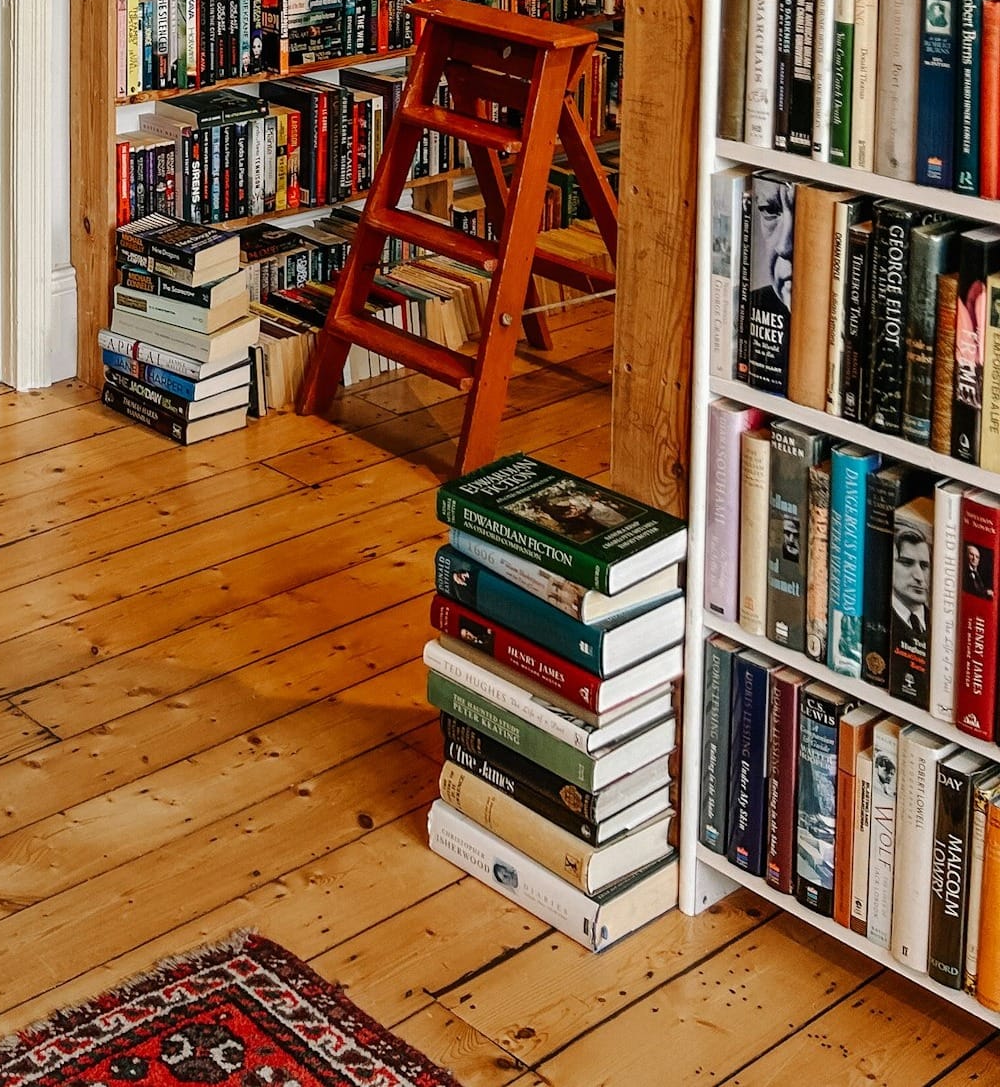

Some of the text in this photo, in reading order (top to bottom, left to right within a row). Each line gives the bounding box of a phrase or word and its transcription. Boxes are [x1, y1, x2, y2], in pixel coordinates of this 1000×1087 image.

[158, 10, 168, 54] SILENCED
[783, 8, 793, 54] DARKNESS
[962, 30, 977, 65] Burns
[832, 31, 846, 125] You Can't Catch Death
[858, 47, 868, 100] Donald Thomas
[126, 278, 155, 292] CONNELLY
[128, 272, 152, 284] MICHAEL
[849, 254, 865, 337] TELLER OF TALES
[877, 275, 887, 301] LIFE
[885, 224, 905, 348] GEORGE ELIOT
[750, 323, 784, 345] DICKEY
[751, 308, 784, 330] JAMES
[148, 370, 183, 391] HARPER
[771, 432, 795, 447] JOAN
[771, 441, 805, 458] MELLEN
[459, 458, 538, 495] EDWARDIAN
[480, 470, 537, 497] FICTION
[463, 508, 573, 567] EDWARDIAN FICTION
[467, 540, 496, 565] 1606
[471, 524, 500, 545] OXFORD
[499, 538, 542, 563] COMPANION
[842, 467, 858, 615] DANGEROUS FRIENDS
[944, 522, 956, 615] TED HUGHES
[506, 645, 566, 683] HENRY JAMES
[973, 618, 984, 696] HENRY JAMES
[443, 660, 507, 703] TED HUGHES
[453, 701, 521, 746] PETER KEATING
[448, 741, 515, 794] Clive James
[737, 760, 750, 831] Under My Skin
[914, 756, 926, 830] ROBERT LOWELL
[435, 834, 490, 874] ISHERWOOD
[441, 827, 486, 859] CHRISTOPHER
[874, 804, 895, 873] WOLF
[931, 839, 945, 899] LOWRY
[943, 833, 963, 918] MALCOLM
